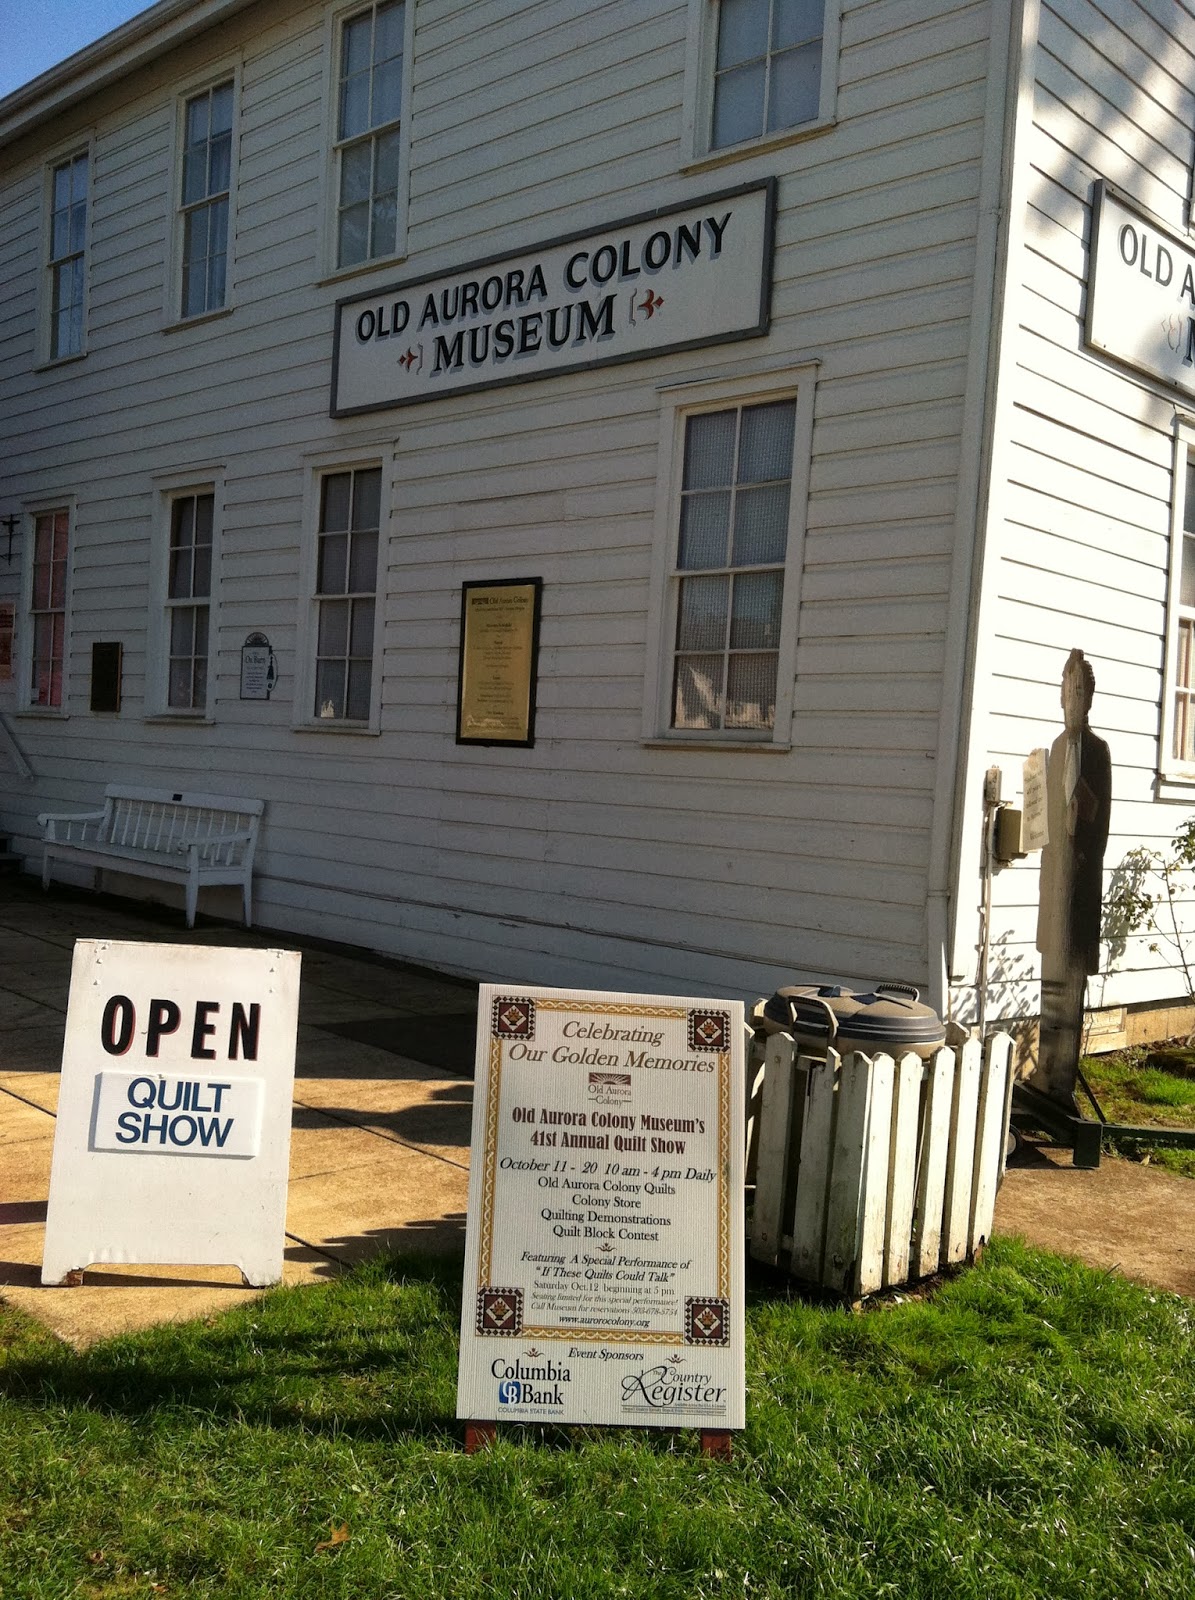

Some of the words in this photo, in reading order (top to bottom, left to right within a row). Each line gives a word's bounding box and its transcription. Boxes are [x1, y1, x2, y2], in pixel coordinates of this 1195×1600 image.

[1119, 223, 1173, 287] OLD
[356, 300, 410, 344] OLD
[418, 267, 548, 331] AURORA
[565, 212, 732, 290] COLONY
[432, 293, 617, 374] MUSEUM
[101, 994, 261, 1061] OPEN
[562, 1020, 665, 1048] Celebrating
[509, 1043, 548, 1062] Our
[552, 1046, 619, 1066] Golden
[623, 1050, 715, 1073] Memories
[127, 1077, 231, 1112] QUILT
[588, 1084, 603, 1094] Old
[605, 1086, 631, 1096] Aurora
[595, 1095, 623, 1109] Colony
[116, 1111, 234, 1147] SHOW
[512, 1106, 535, 1123] Old
[540, 1108, 587, 1126] Aurora
[591, 1111, 636, 1131] Colony
[641, 1114, 705, 1134] Museum's
[530, 1130, 557, 1147] 41st
[561, 1132, 609, 1150] Annual
[614, 1134, 646, 1153] Quilt
[651, 1137, 686, 1155] Show
[500, 1157, 550, 1171] October
[553, 1160, 567, 1172] 11
[582, 1161, 598, 1174] 20
[604, 1163, 620, 1175] 10
[621, 1167, 640, 1176] am
[651, 1166, 660, 1178] 4
[661, 1169, 681, 1181] pm
[684, 1167, 717, 1183] Daily
[538, 1176, 558, 1188] Old
[562, 1178, 600, 1190] Aurora
[603, 1180, 641, 1194] Colony
[644, 1182, 676, 1195] Quilts
[572, 1193, 610, 1209] Colony
[613, 1196, 641, 1208] Store
[541, 1208, 584, 1224] Quilting
[587, 1210, 671, 1226] Demonstrations
[553, 1224, 581, 1238] Quilt
[584, 1226, 615, 1239] Block
[618, 1228, 659, 1241] Contest
[520, 1251, 566, 1265] Featuring
[569, 1254, 578, 1264] A
[582, 1254, 616, 1266] Special
[618, 1256, 678, 1269] Performance
[680, 1259, 692, 1269] of
[553, 1267, 582, 1278] These
[585, 1269, 613, 1280] Quilts
[616, 1270, 646, 1281] Could
[534, 1280, 568, 1292] Saturday
[604, 1283, 642, 1295] beginning
[654, 1286, 659, 1294] 5
[661, 1288, 675, 1297] pm
[583, 1294, 592, 1302] for
[608, 1296, 631, 1304] special
[546, 1302, 577, 1311] Museum
[578, 1304, 589, 1312] for
[568, 1347, 597, 1359] Event
[598, 1349, 644, 1362] Sponsors
[491, 1358, 571, 1382] Columbia
[661, 1366, 712, 1387] Country
[522, 1384, 564, 1405] Bank
[621, 1365, 727, 1407] Register
[548, 1408, 564, 1416] BANK
